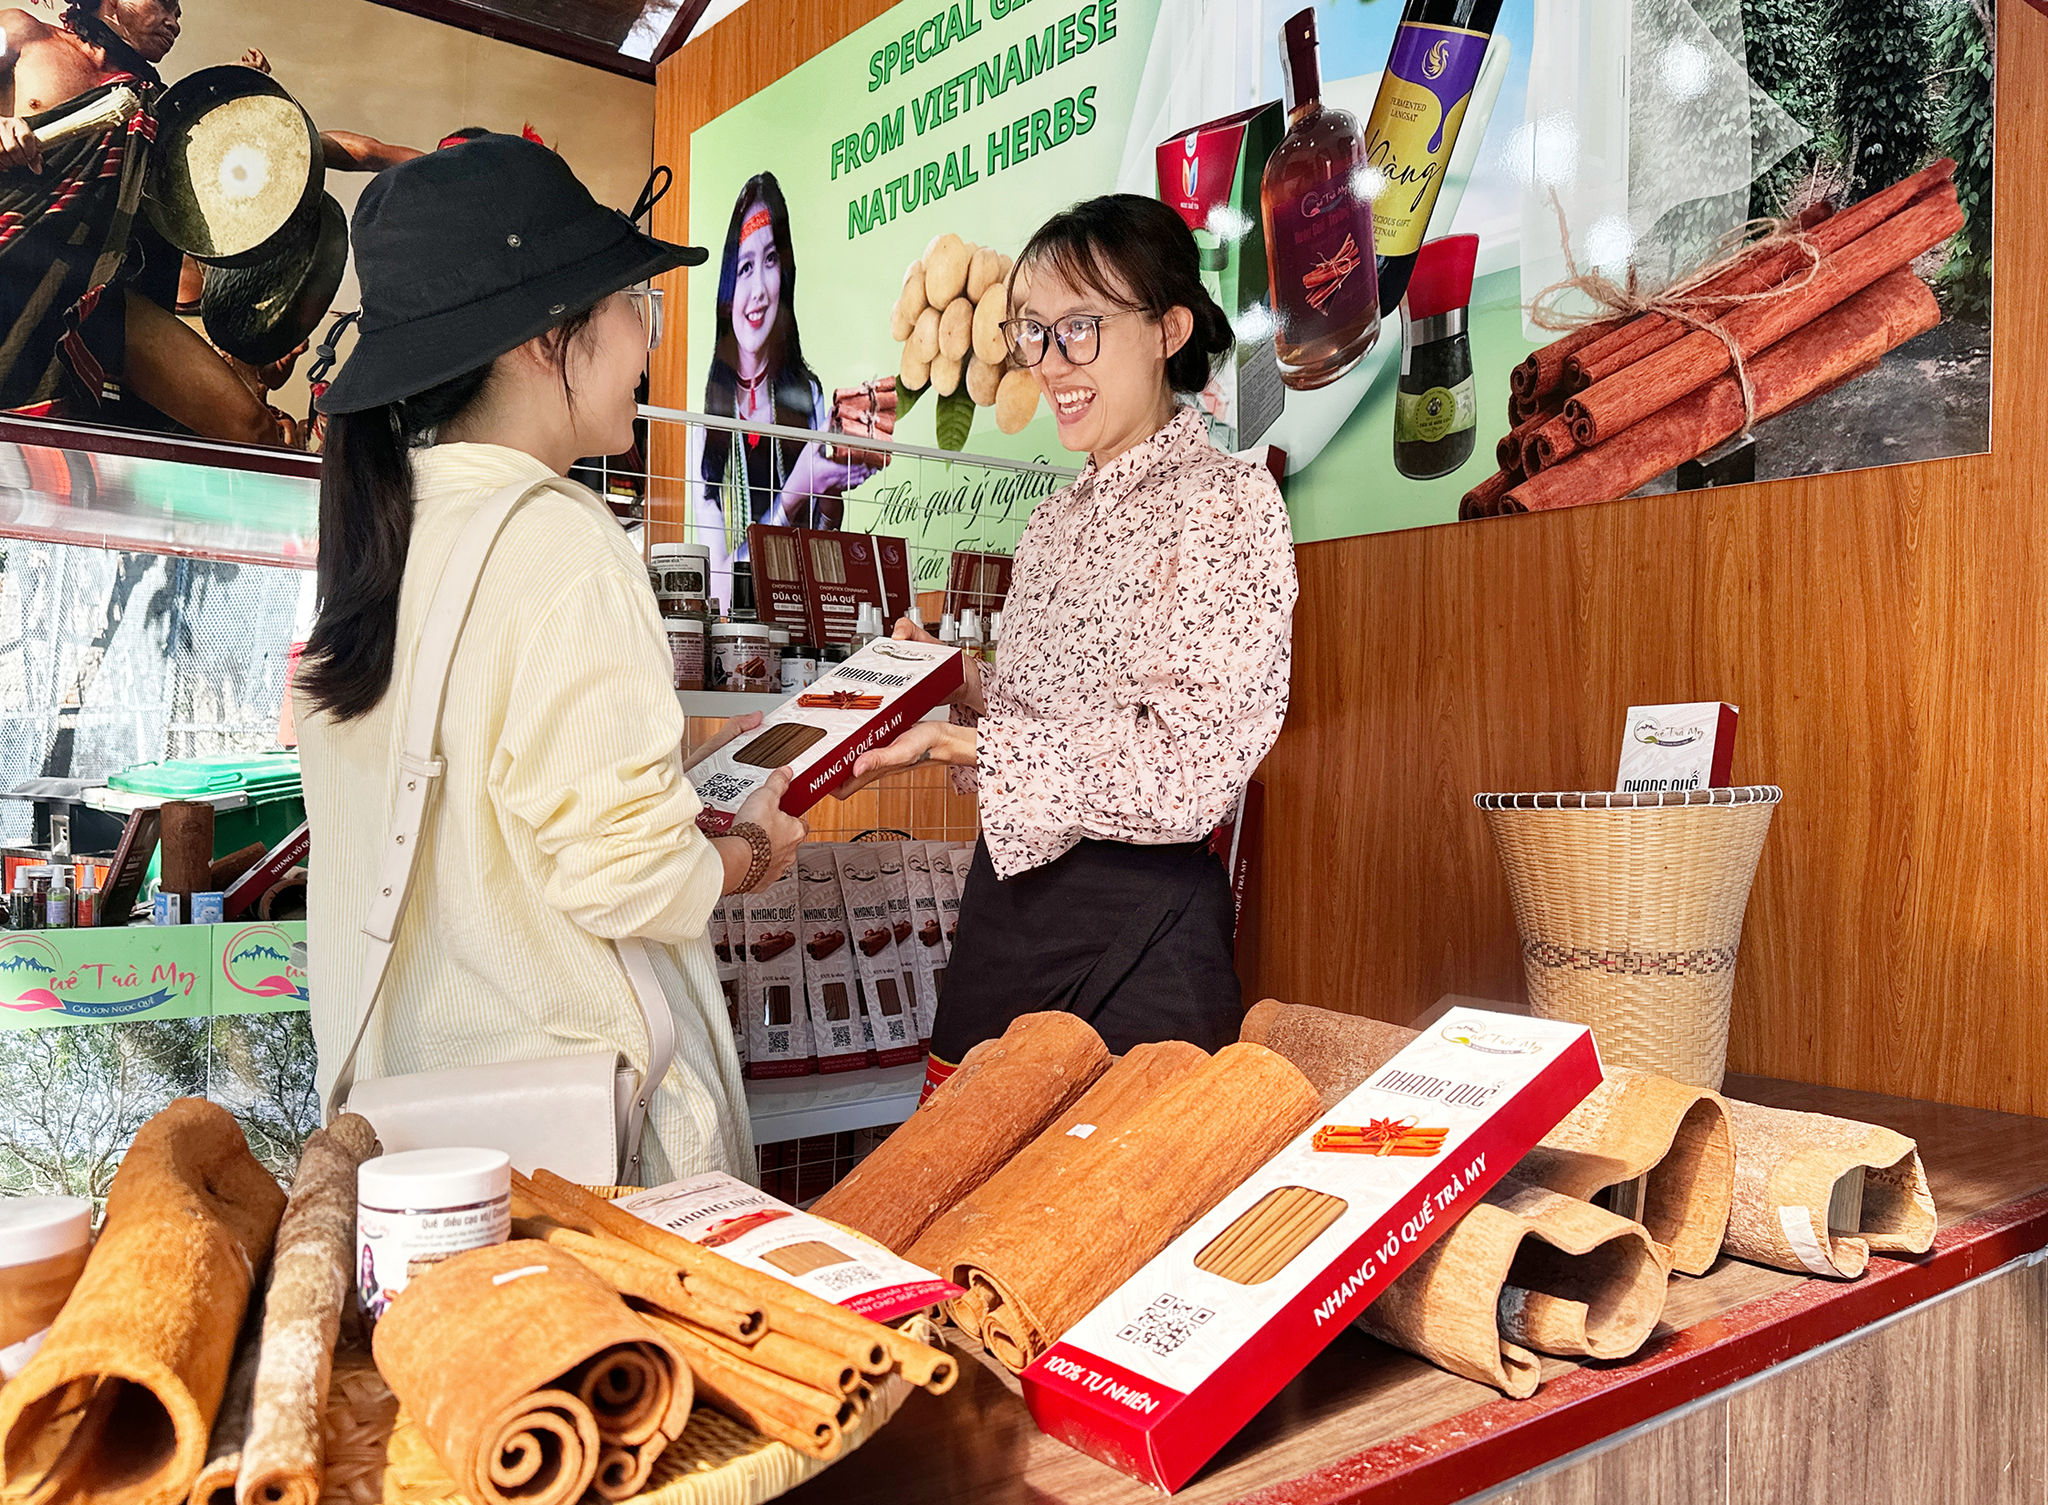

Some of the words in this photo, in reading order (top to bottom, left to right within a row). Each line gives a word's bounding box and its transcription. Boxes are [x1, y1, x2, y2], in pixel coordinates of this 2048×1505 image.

[868, 0, 982, 92] SPECIAL
[831, 105, 905, 181] FROM
[911, 0, 1117, 135] VIETNAMESE
[847, 151, 978, 240] NATURAL
[987, 86, 1098, 177] HERBS
[921, 475, 970, 539] quà
[772, 591, 791, 601] ĐŨA
[791, 594, 803, 602] QU
[820, 592, 838, 602] ĐŨA
[839, 594, 856, 604] QUẾ
[834, 666, 883, 682] NHANG
[809, 759, 843, 794] NHANG
[842, 746, 856, 766] VỎ
[856, 729, 874, 756] QUẾ
[874, 720, 891, 741] TRÀ
[890, 711, 903, 729] MY
[270, 853, 294, 876] NHANG
[750, 907, 778, 921] NHANG
[778, 903, 796, 921] QUẾ
[803, 907, 828, 921] NHANG
[827, 904, 843, 920] QUẾ
[853, 905, 875, 919] NHANG
[151, 961, 200, 997] My
[72, 1004, 91, 1014] CAO
[111, 1003, 137, 1014] NGỌC
[1375, 1069, 1452, 1099] NHANG
[1445, 1080, 1505, 1109] QUẾ
[665, 1202, 730, 1230] NHANG
[1312, 1258, 1377, 1327] NHANG
[1375, 1230, 1400, 1265] VỎ
[1400, 1193, 1435, 1244] QUẾ
[1433, 1173, 1465, 1211] TRÀ
[1464, 1152, 1487, 1186] MY
[1043, 1355, 1087, 1382] 100%
[1081, 1370, 1114, 1393] TỰ
[1102, 1381, 1160, 1415] NHIÊN
